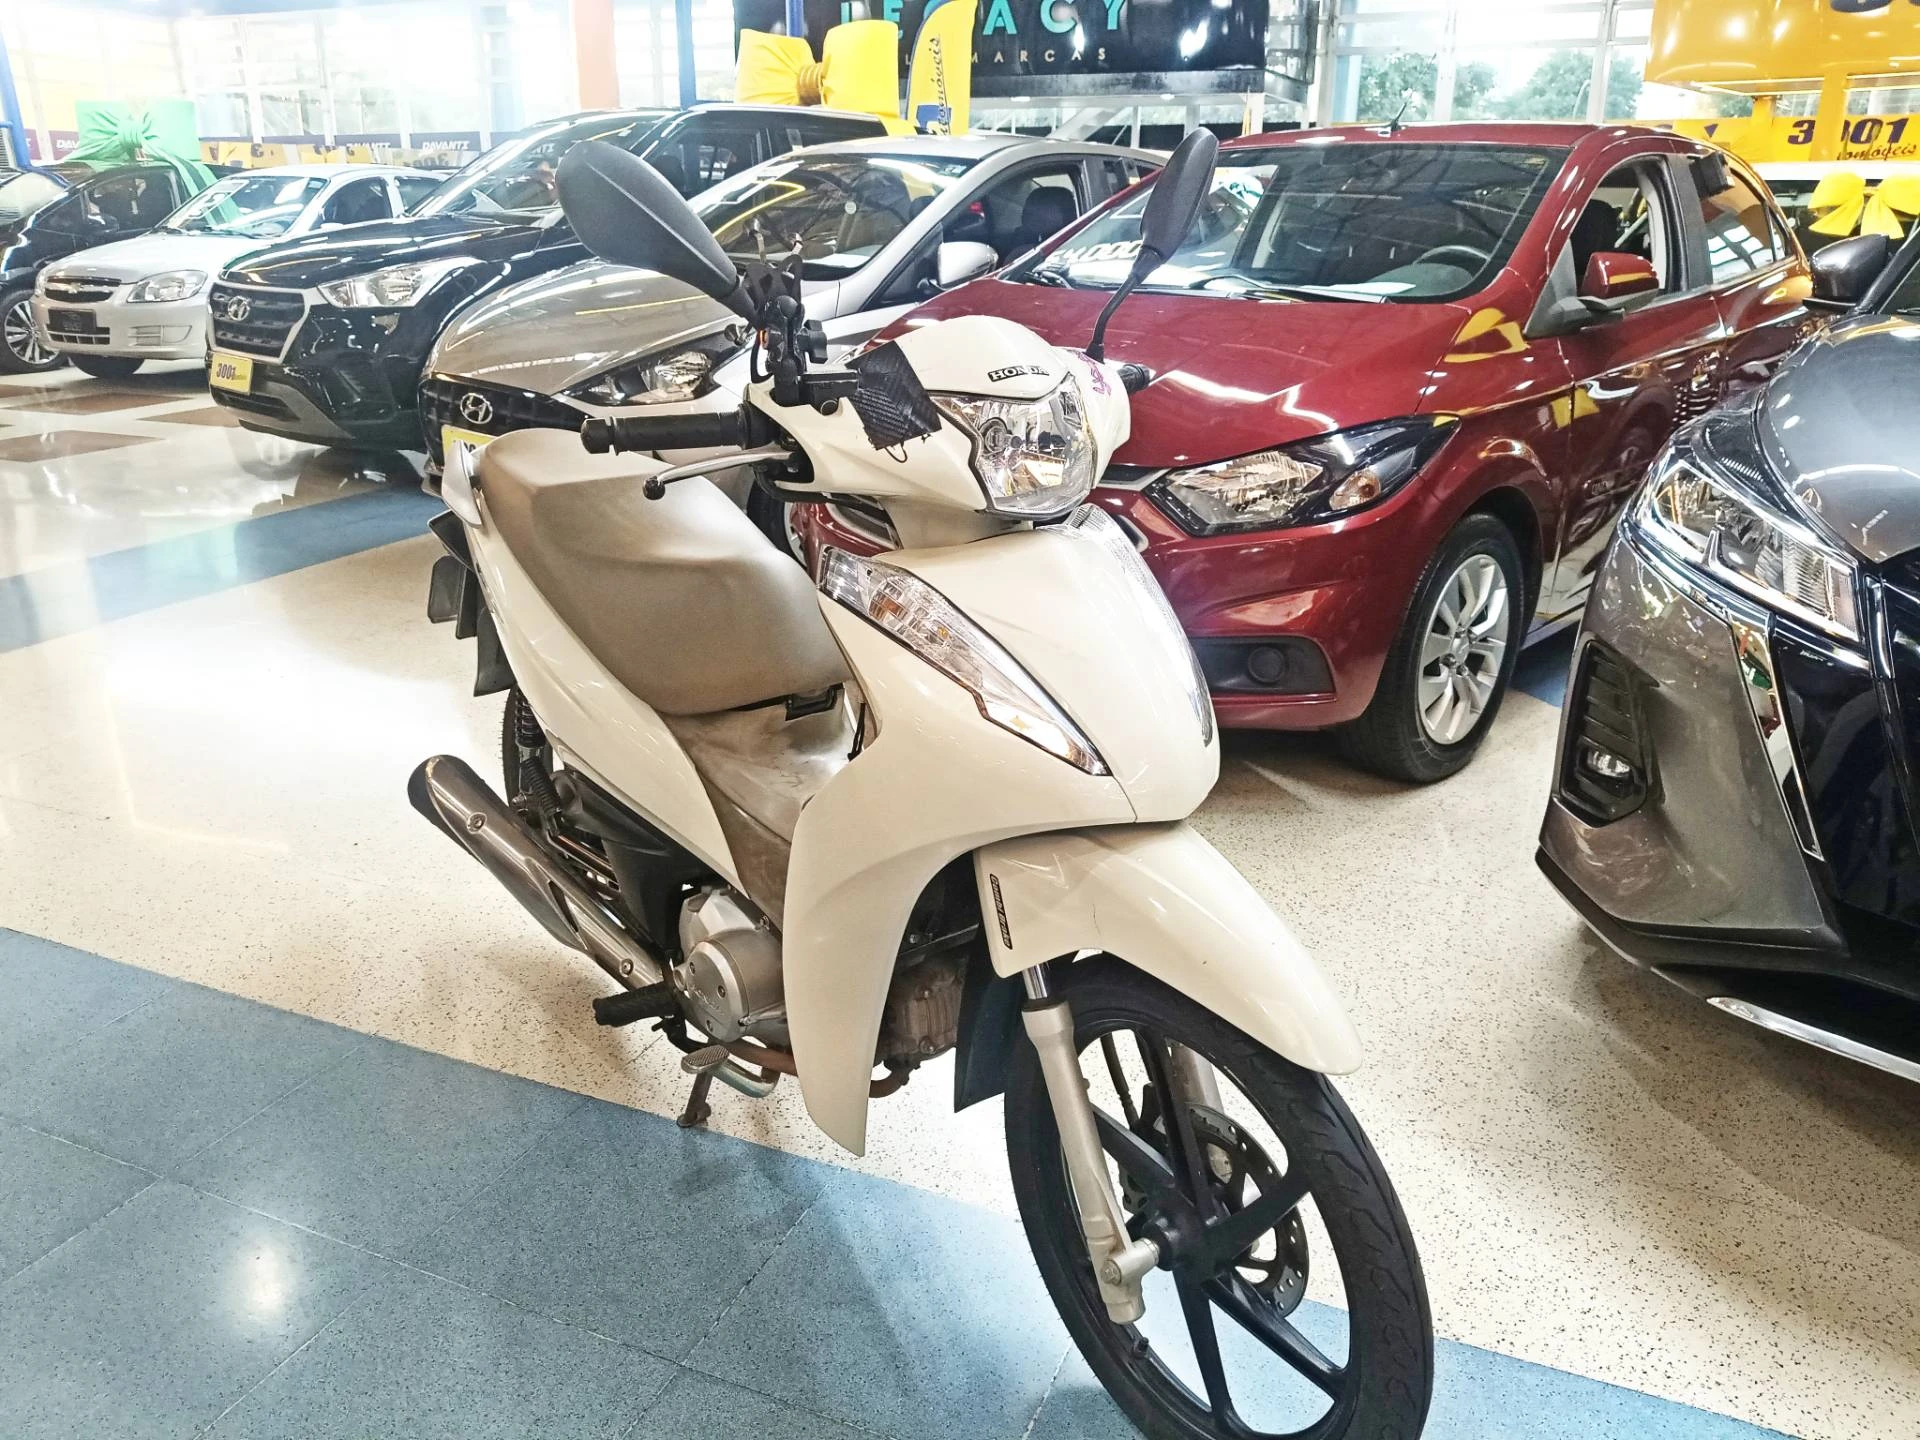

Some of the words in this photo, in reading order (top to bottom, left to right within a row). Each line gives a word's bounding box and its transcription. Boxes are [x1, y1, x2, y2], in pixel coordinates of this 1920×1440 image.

[841, 0, 1127, 39] EACY
[1787, 117, 1909, 145] 301
[422, 140, 470, 152] DAVANTI
[216, 362, 237, 380] 3001
[988, 365, 1050, 382] HONDA
